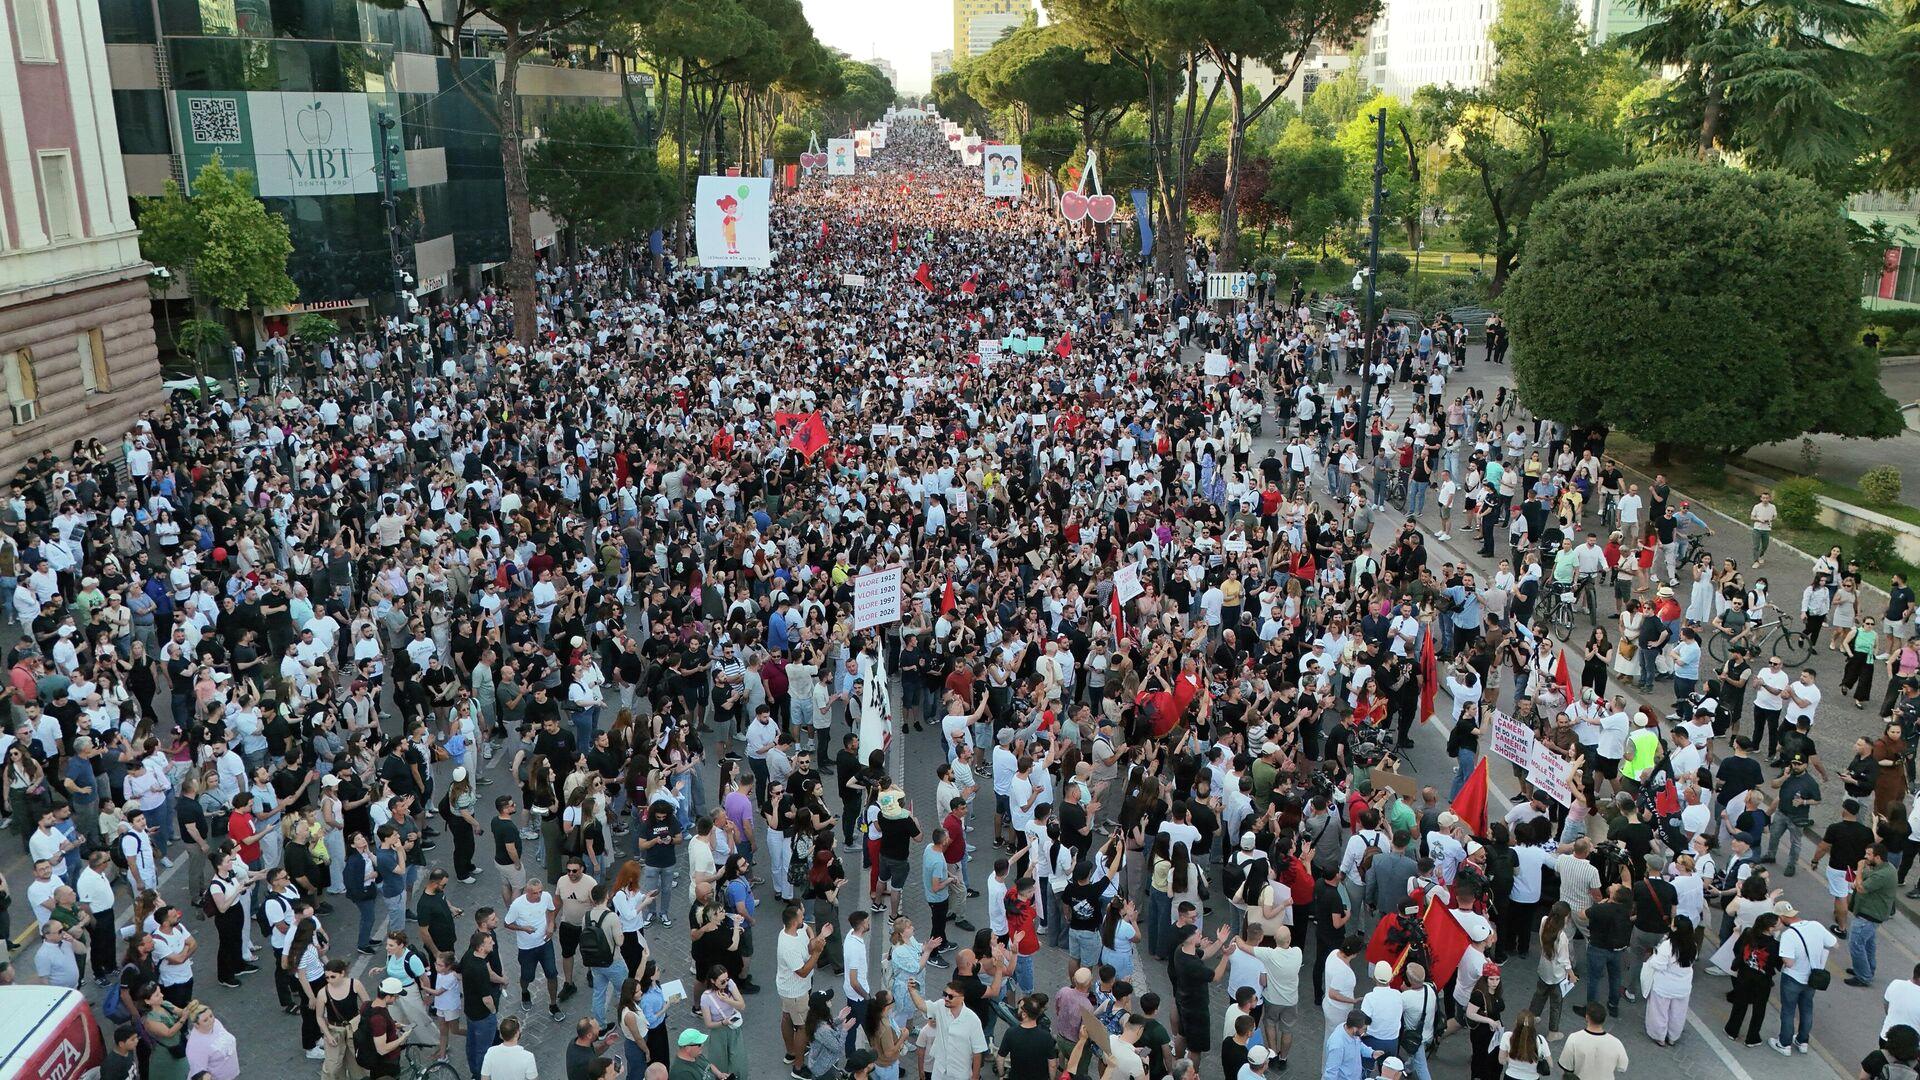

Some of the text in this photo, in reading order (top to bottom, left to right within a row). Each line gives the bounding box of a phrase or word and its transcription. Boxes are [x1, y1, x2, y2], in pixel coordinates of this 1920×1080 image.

[286, 149, 352, 179] MBT
[880, 573, 896, 583] 1912
[880, 585, 896, 594] 1920
[880, 596, 895, 606] 1997
[879, 607, 895, 617] 2026
[1497, 718, 1525, 737] ÇAMERI
[1495, 732, 1527, 754] ÇAMERIA
[1502, 729, 1510, 737] DO
[1511, 733, 1528, 746] VIJME
[1494, 744, 1527, 767] SHQIPERI
[1541, 752, 1564, 772] ÇAMERIA
[1531, 759, 1547, 775] MOLLE
